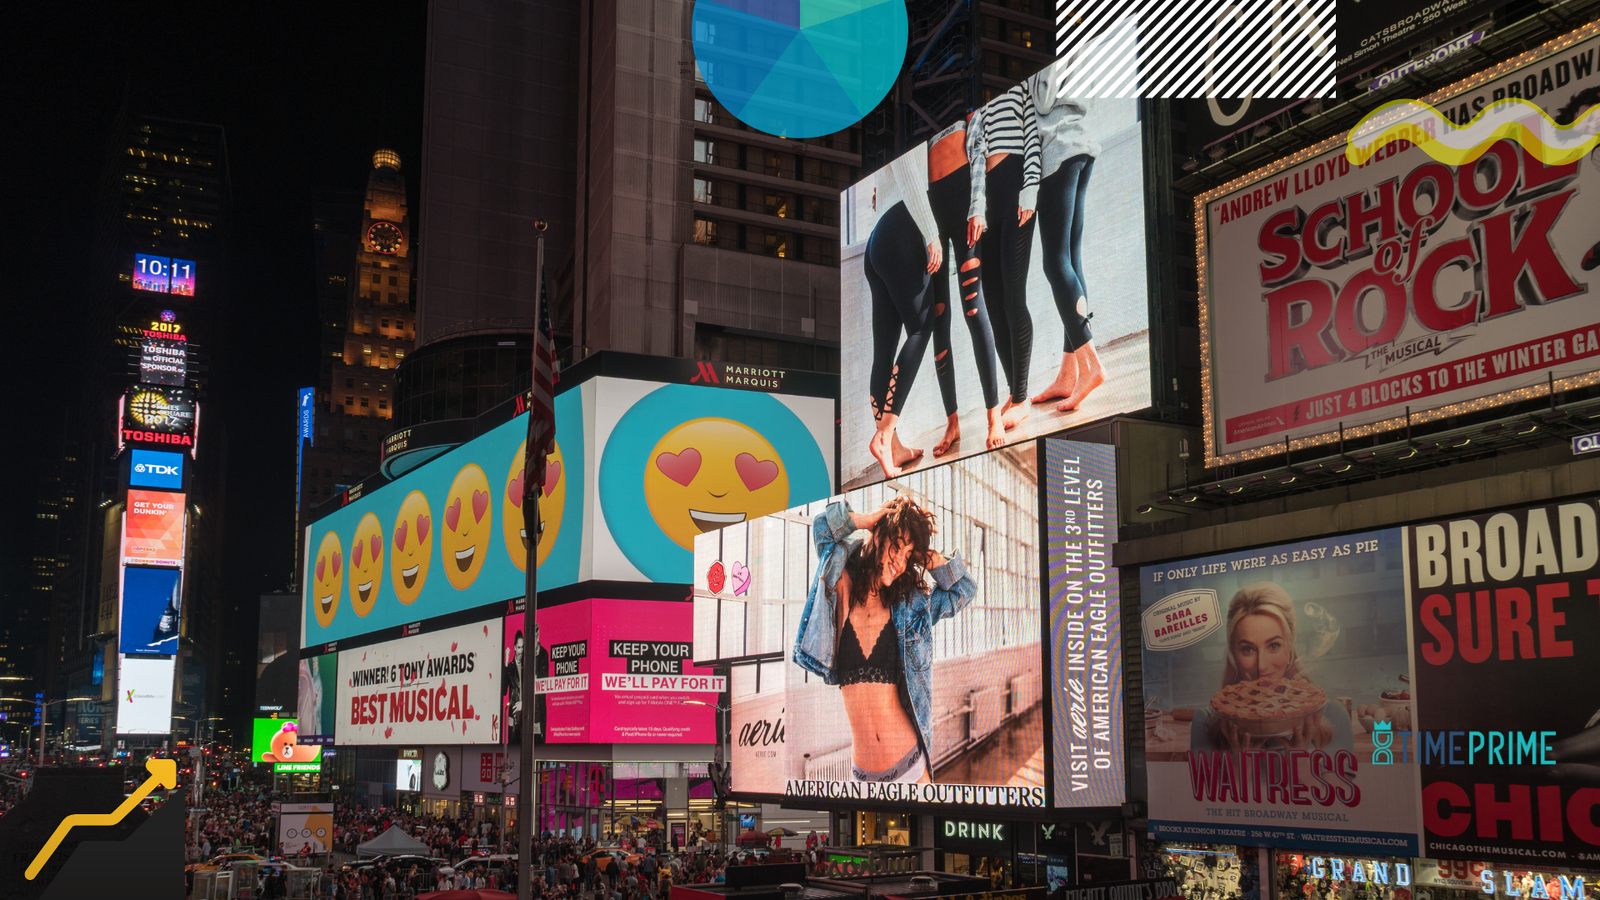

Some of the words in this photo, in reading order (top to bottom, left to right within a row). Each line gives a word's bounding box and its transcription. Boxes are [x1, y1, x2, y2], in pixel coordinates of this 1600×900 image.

[1337, 54, 1353, 67] Neil
[1354, 41, 1380, 59] Simon
[1381, 24, 1416, 44] Theatre
[1432, 10, 1451, 24] 250
[1452, 0, 1478, 14] West
[1360, 0, 1456, 47] CATSBROADWA
[1378, 34, 1474, 89] OUTFRONT
[1293, 150, 1350, 196] LLOYD
[1355, 117, 1436, 169] WEBBER
[1442, 96, 1485, 135] HAS
[1493, 46, 1600, 115] BROADW
[1257, 112, 1582, 287] SCHOOL
[1373, 217, 1435, 284] of
[138, 259, 191, 279] 10:11
[1262, 187, 1589, 383] ROCK
[143, 330, 187, 342] TOSHIBA
[151, 322, 181, 333] 2017
[143, 345, 186, 356] TOSHIBA
[152, 355, 185, 365] OFFICIAL
[1370, 345, 1390, 360] THE
[1384, 335, 1442, 366] MUSICAL
[142, 363, 177, 373] SPONSOR
[725, 364, 786, 379] MARRIOTT
[1305, 394, 1343, 420] JUST
[1347, 391, 1357, 409] 4
[1361, 375, 1423, 405] BLOCKS
[1426, 368, 1450, 388] TO
[1453, 359, 1487, 384] THE
[1492, 338, 1566, 371] WINTER
[725, 375, 779, 388] MARQUIS
[159, 409, 190, 418] SQUARE
[302, 409, 310, 438] AWARDS
[123, 429, 193, 446] TOSHIBA
[145, 464, 179, 475] TDK
[1063, 456, 1080, 505] LEVEL
[134, 501, 150, 509] GET
[152, 502, 174, 510] YOUR
[1065, 509, 1081, 535] 3RD
[1087, 477, 1106, 583] OUTFITTERS
[1415, 500, 1600, 589] BROAD
[1066, 541, 1082, 575] THE
[1153, 571, 1164, 582] IF
[1167, 566, 1198, 581] ONLY
[1201, 561, 1227, 576] LIFE
[1230, 556, 1266, 572] WERE
[1270, 552, 1288, 567] AS
[1291, 547, 1327, 563] EASY
[1331, 543, 1351, 558] AS
[1355, 539, 1379, 554] PIE
[1067, 580, 1083, 604] ON
[1177, 599, 1193, 609] MUSIC
[1090, 590, 1108, 642] EAGLE
[1154, 613, 1208, 638] BAREILLES
[1165, 608, 1192, 623] SARA
[1420, 582, 1574, 666] SURE
[552, 645, 567, 659] KEEP
[568, 643, 586, 657] YOUR
[613, 643, 649, 656] KEEP
[651, 643, 689, 657] YOUR
[1068, 610, 1086, 671] INSIDE
[352, 666, 389, 688] WINNER!
[391, 666, 396, 682] 6
[398, 660, 425, 681] TONY
[426, 652, 475, 678] AWARDS
[556, 661, 578, 674] PHONE
[631, 659, 678, 673] PHONE
[536, 679, 553, 692] WE'LL
[554, 679, 566, 690] PAY
[567, 677, 580, 689] FOR
[580, 676, 587, 688] IT
[605, 676, 649, 689] WE'LL
[651, 677, 677, 689] PAY
[681, 677, 708, 689] FOR
[712, 678, 724, 690] IT
[351, 693, 388, 725] BEST
[390, 684, 474, 724] MUSICAL
[1091, 650, 1111, 741] AMERICAN
[1063, 678, 1087, 740] aerie
[293, 763, 321, 771] FRIENDS
[1071, 743, 1088, 792] VISIT
[1094, 748, 1111, 769] OF
[1186, 749, 1361, 808] WAITRESS
[785, 779, 862, 800] AMERICAN
[866, 782, 919, 802] EAGLE
[923, 784, 1044, 807] OUTFITTERS
[1206, 808, 1222, 817] THE
[1225, 808, 1241, 818] HIT
[1243, 809, 1298, 821] BROADWAY
[1302, 811, 1349, 823] MUSICAL
[945, 821, 1005, 841] DRINK
[1158, 825, 1182, 833] BROOKS
[1183, 826, 1215, 835] ATKINSON
[1216, 828, 1245, 837] THEATRE
[1285, 832, 1295, 840] ST.
[1301, 833, 1408, 847] WAITRESSTHEMUSICAL.COM
[1429, 842, 1567, 859] CHICAGOTHEMUSICAL.COM
[1312, 857, 1411, 886] GRAND
[1446, 878, 1472, 887] SOUVENIR
[1065, 886, 1106, 900] MIGHTY
[1108, 882, 1153, 900] QUINN'S
[1154, 880, 1177, 900] BBQ
[1481, 869, 1585, 900] SLAM
